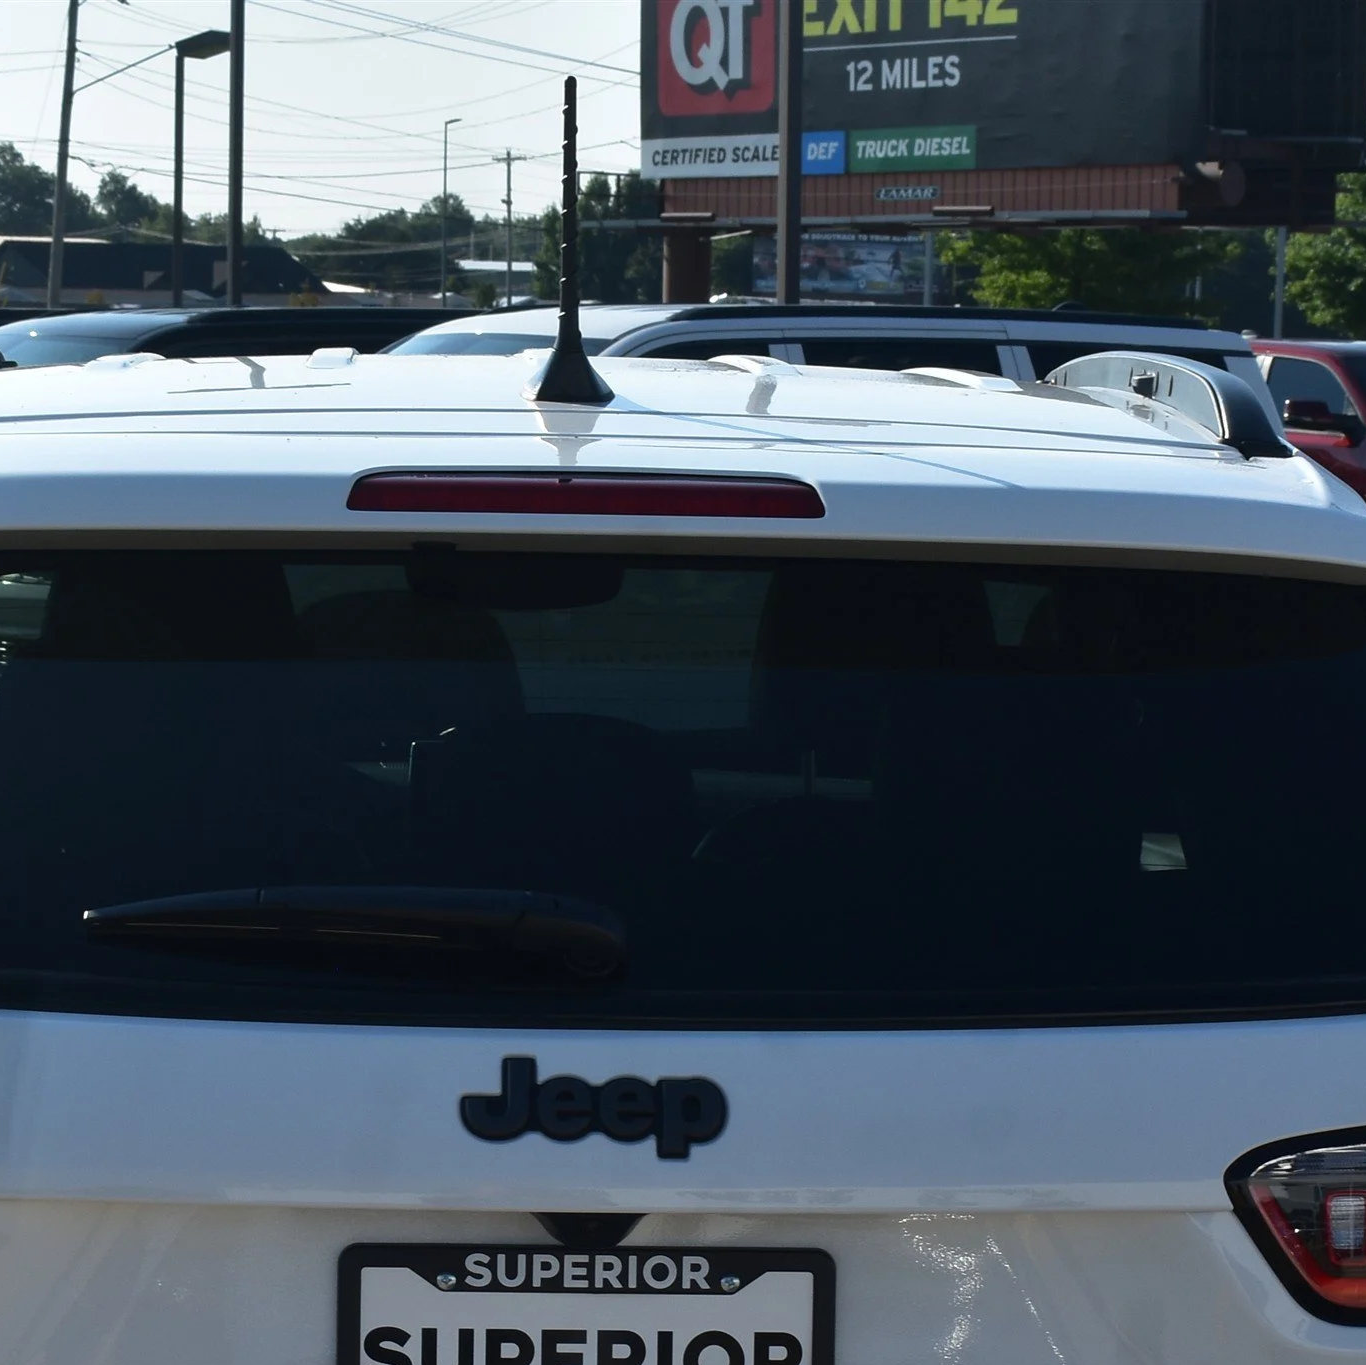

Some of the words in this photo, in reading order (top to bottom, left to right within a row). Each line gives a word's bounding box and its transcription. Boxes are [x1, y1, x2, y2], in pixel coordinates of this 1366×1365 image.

[669, 0, 755, 91] QT
[846, 60, 874, 92] 12
[881, 54, 961, 91] MILES
[651, 147, 727, 167] CERTIFIED
[806, 141, 839, 161] DEF
[855, 138, 909, 160] TRUCK
[913, 136, 971, 157] DIESEL
[460, 1055, 729, 1162] Jeep
[464, 1253, 711, 1290] SUPERIOR
